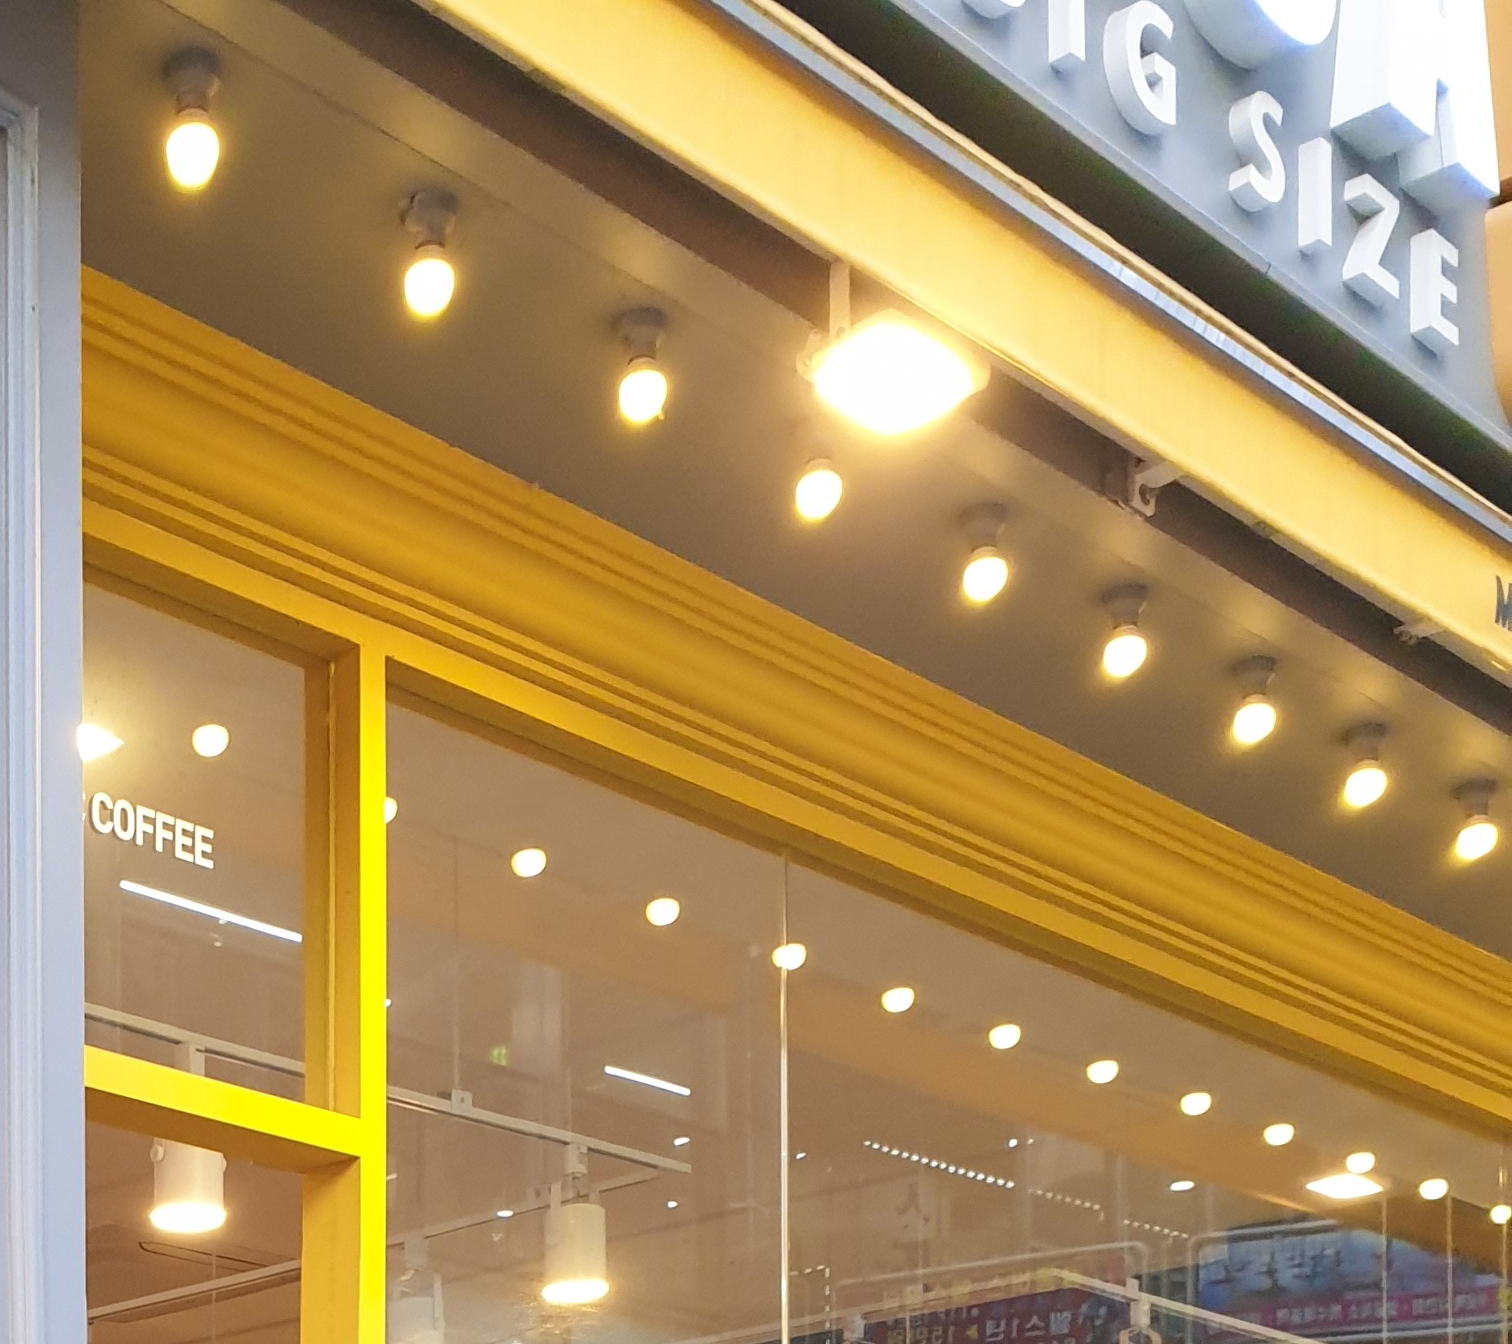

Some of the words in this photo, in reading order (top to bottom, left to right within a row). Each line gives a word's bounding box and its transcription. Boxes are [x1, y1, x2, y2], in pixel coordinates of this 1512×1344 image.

[961, 0, 1178, 136] IG
[1228, 90, 1460, 357] SIZE
[91, 791, 215, 870] COFFEE
